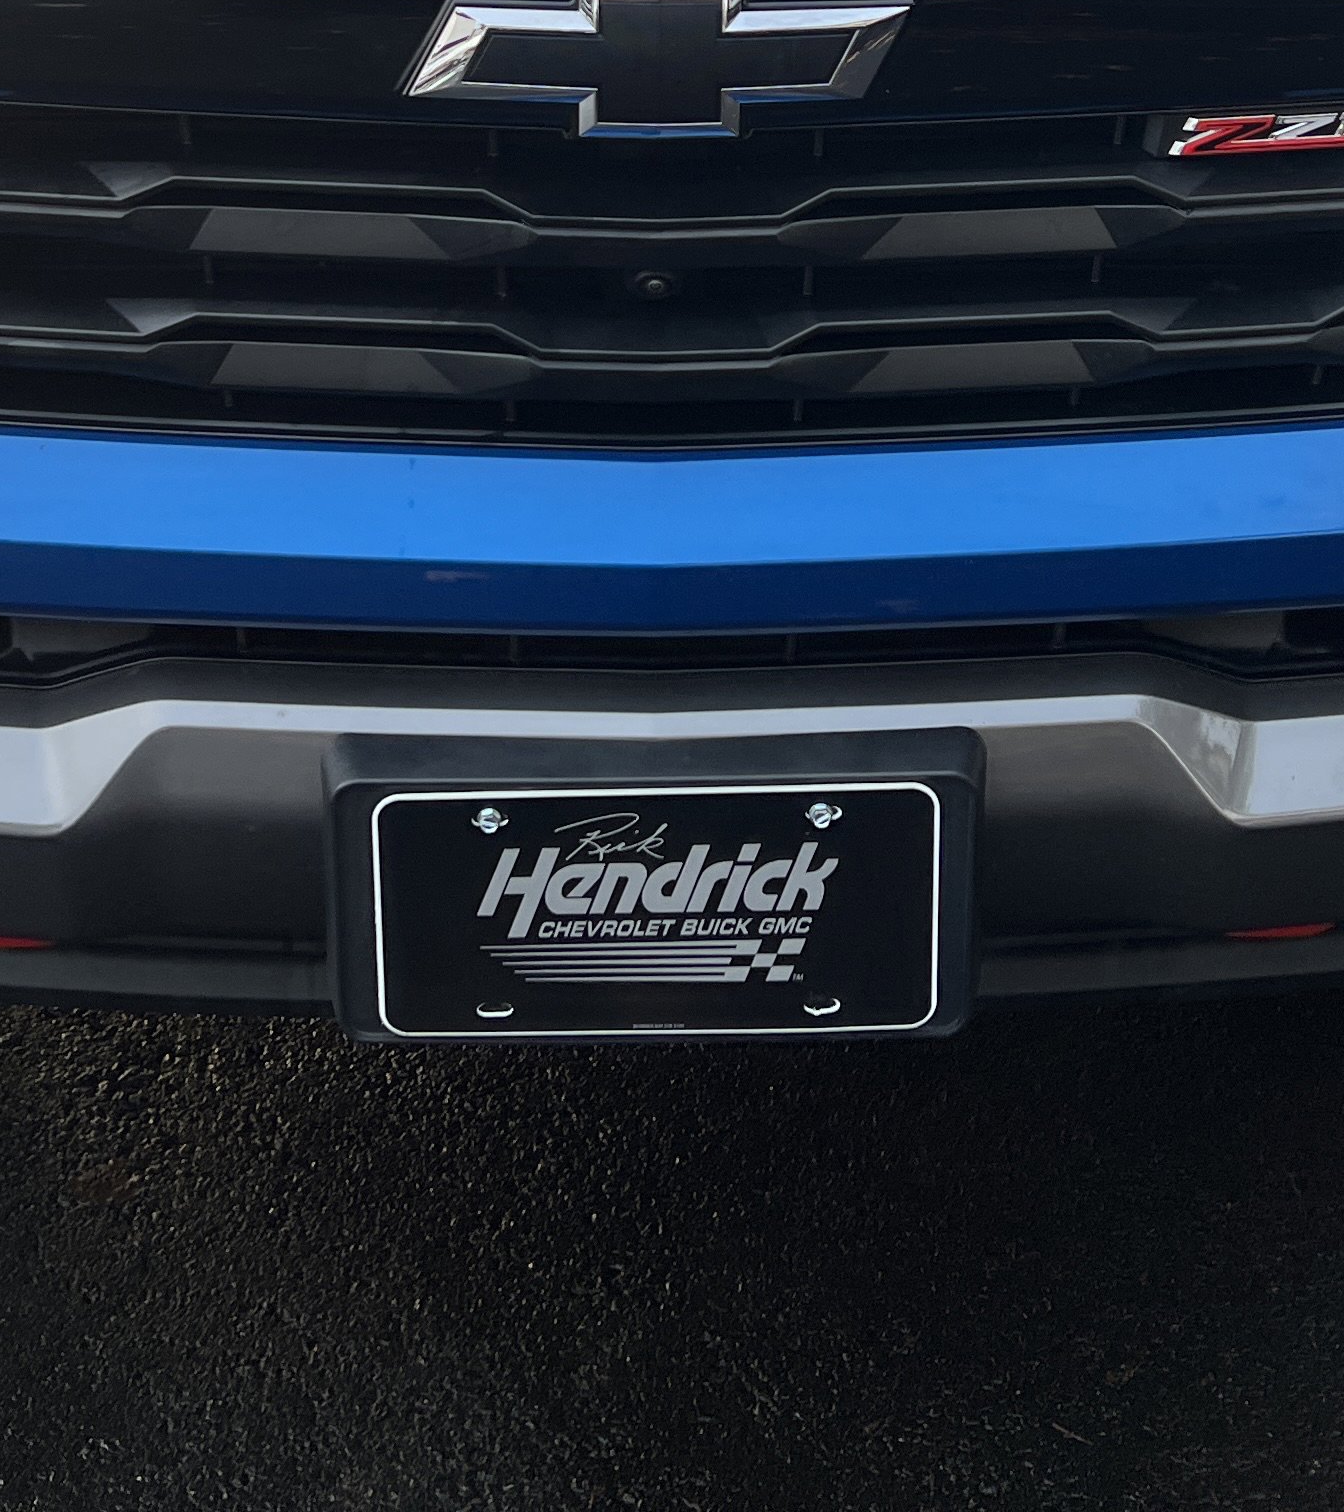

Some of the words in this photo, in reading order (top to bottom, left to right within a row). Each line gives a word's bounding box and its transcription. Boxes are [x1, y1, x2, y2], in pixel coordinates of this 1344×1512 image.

[554, 812, 668, 862] Rick
[476, 842, 839, 938] Hendrick
[538, 918, 677, 939] CHEVROLET
[680, 917, 753, 936] BUICK
[758, 916, 813, 935] GMC
